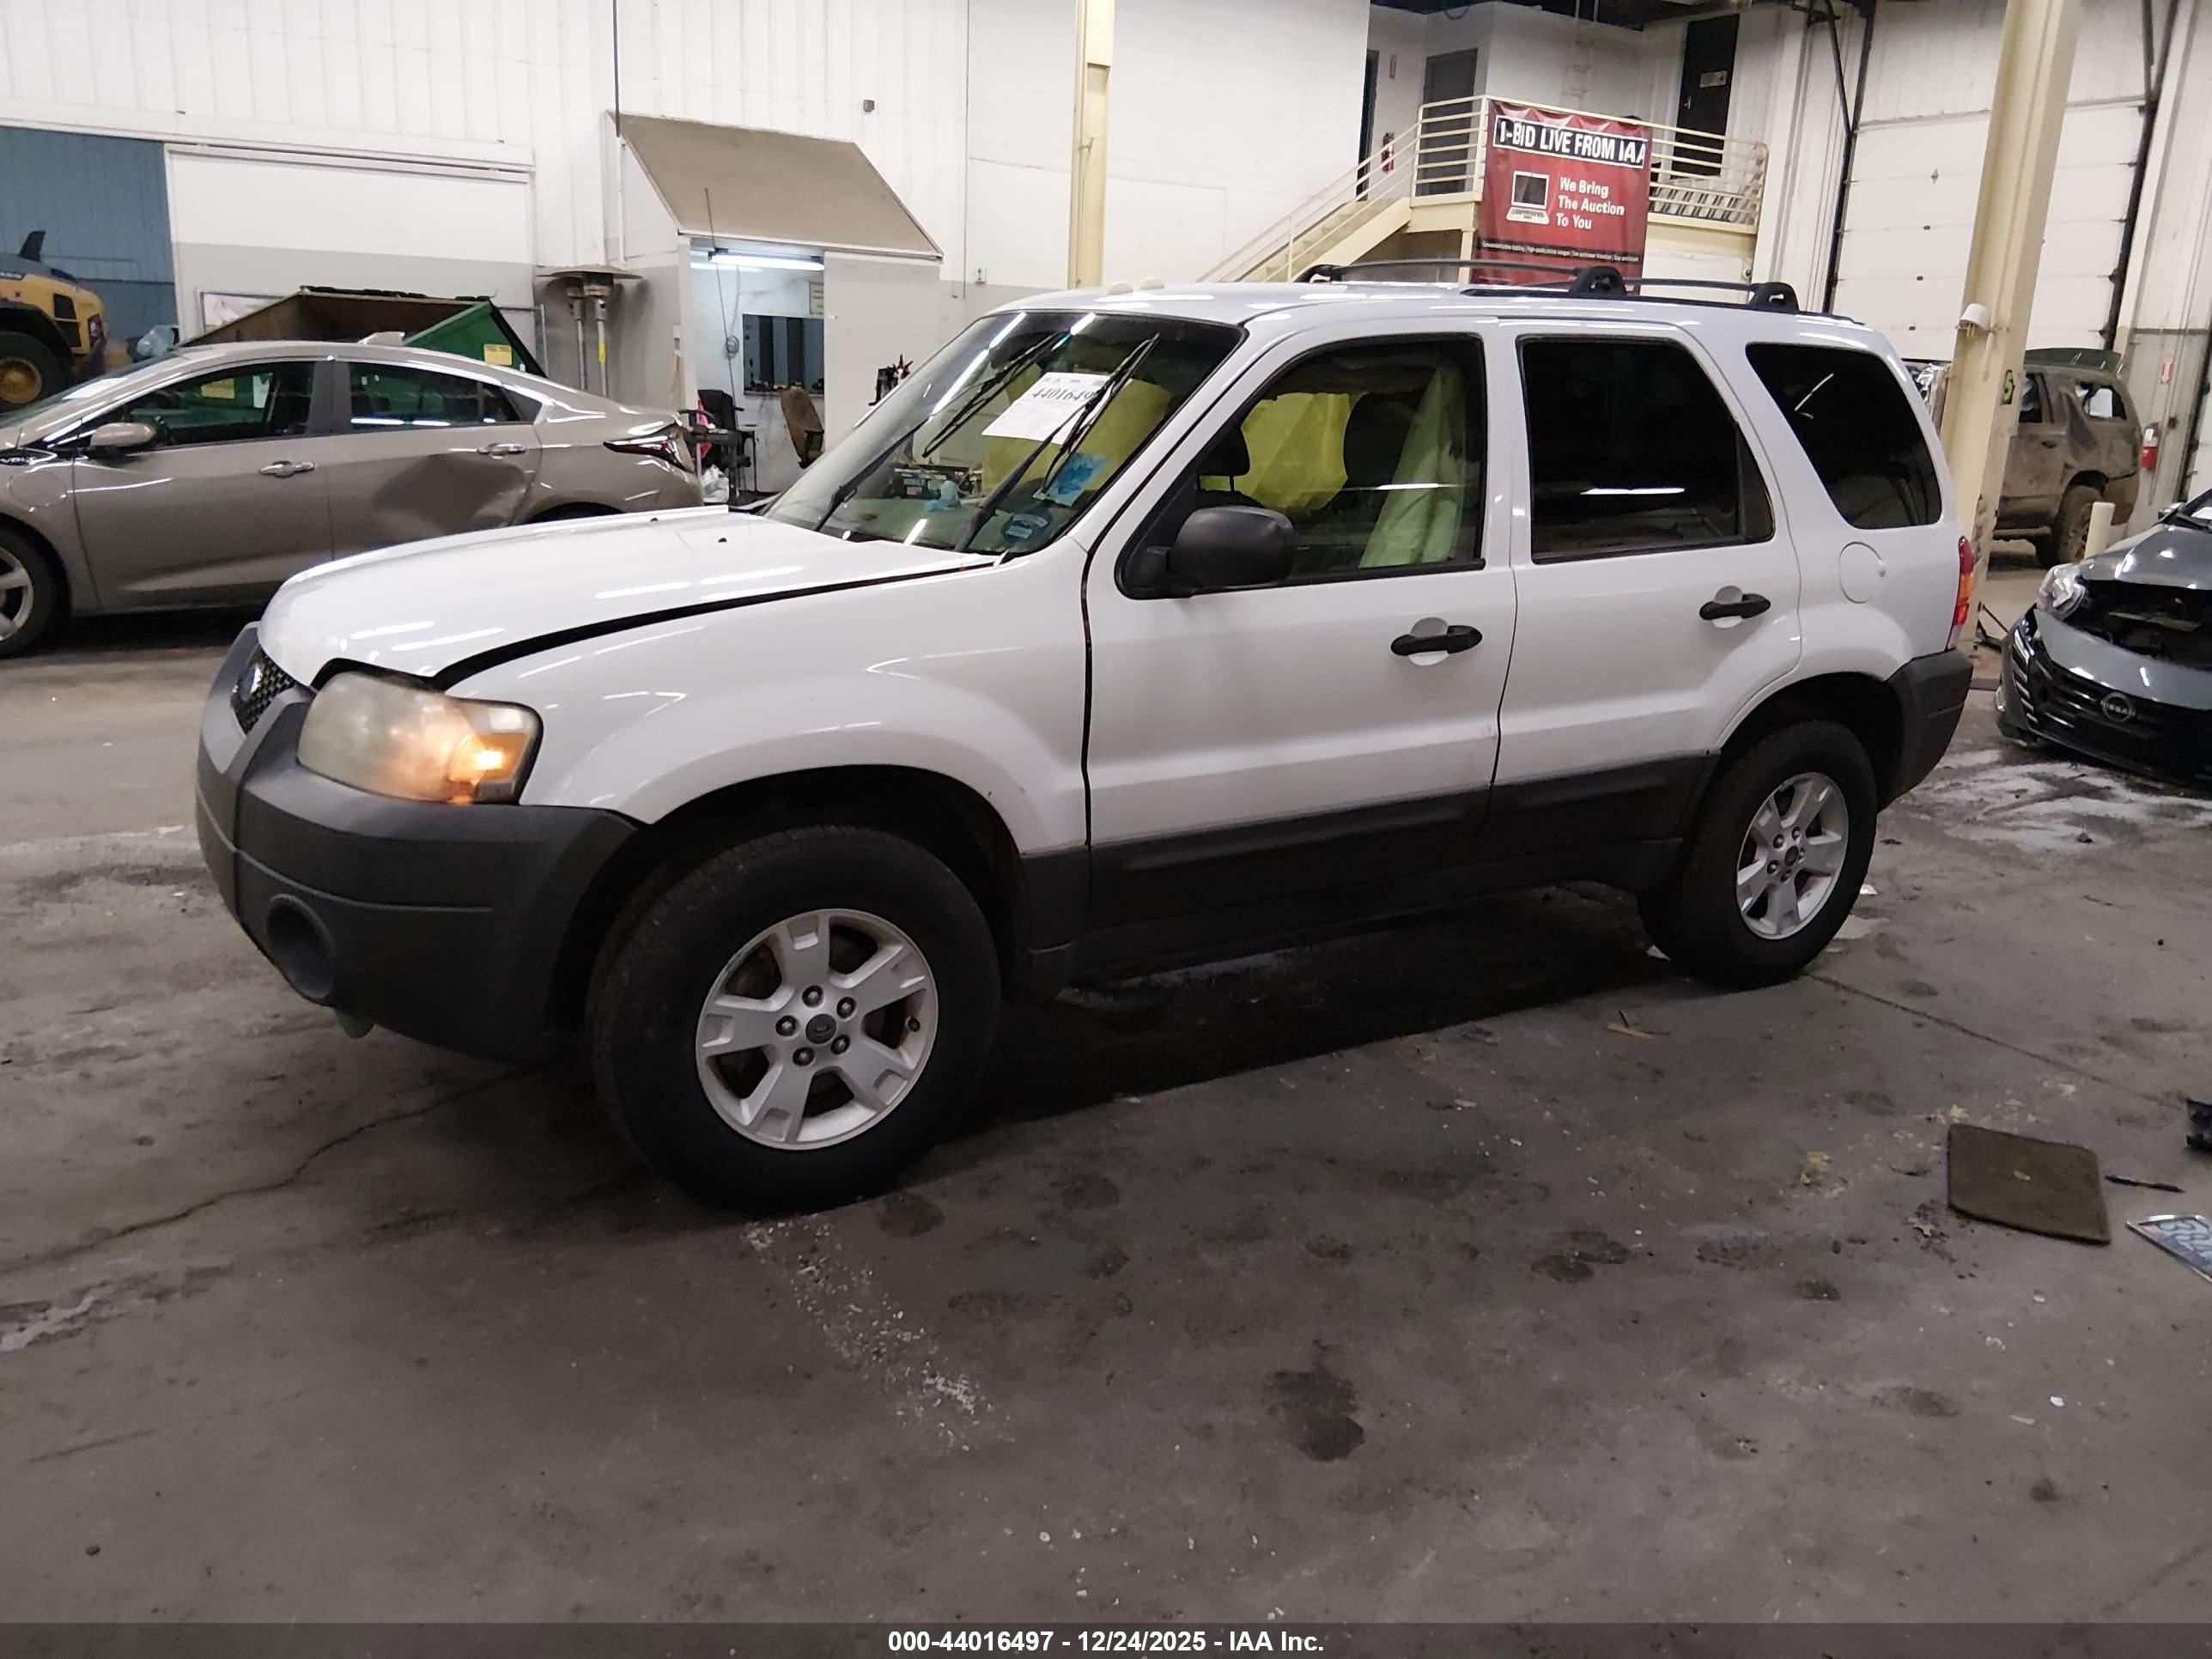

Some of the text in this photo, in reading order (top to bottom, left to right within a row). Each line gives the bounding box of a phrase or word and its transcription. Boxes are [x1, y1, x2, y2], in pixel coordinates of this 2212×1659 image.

[1500, 121, 1536, 147] I-BID
[1540, 129, 1572, 155] LIVE
[1574, 134, 1615, 161] FROM
[1559, 176, 1609, 199] We Bring
[1558, 195, 1626, 216] The Auction
[1556, 213, 1592, 230] To You
